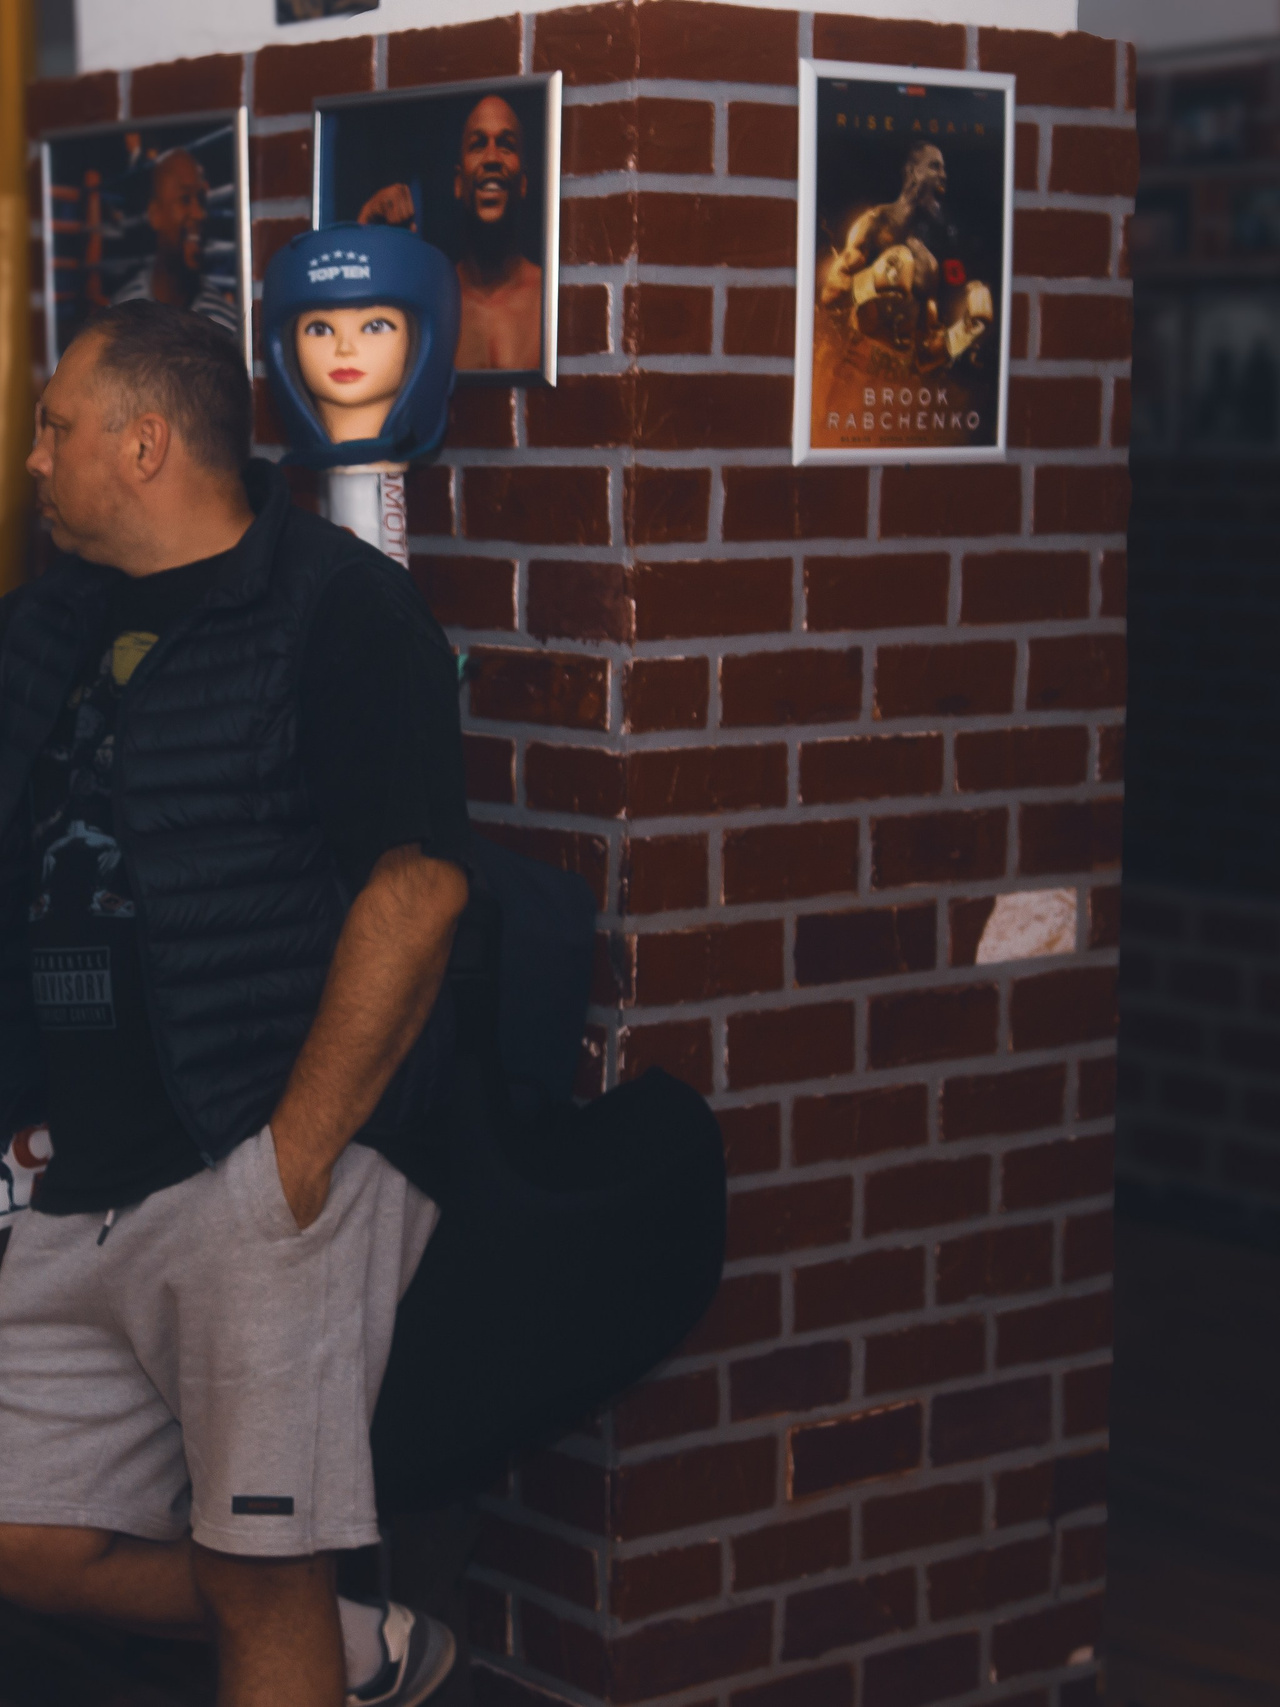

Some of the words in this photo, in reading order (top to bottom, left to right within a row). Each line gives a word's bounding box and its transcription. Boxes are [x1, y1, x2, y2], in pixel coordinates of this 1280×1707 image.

[836, 113, 894, 131] RISE
[913, 118, 985, 136] AGAIN
[863, 386, 949, 406] BROOK
[827, 411, 980, 430] RABCHENKO
